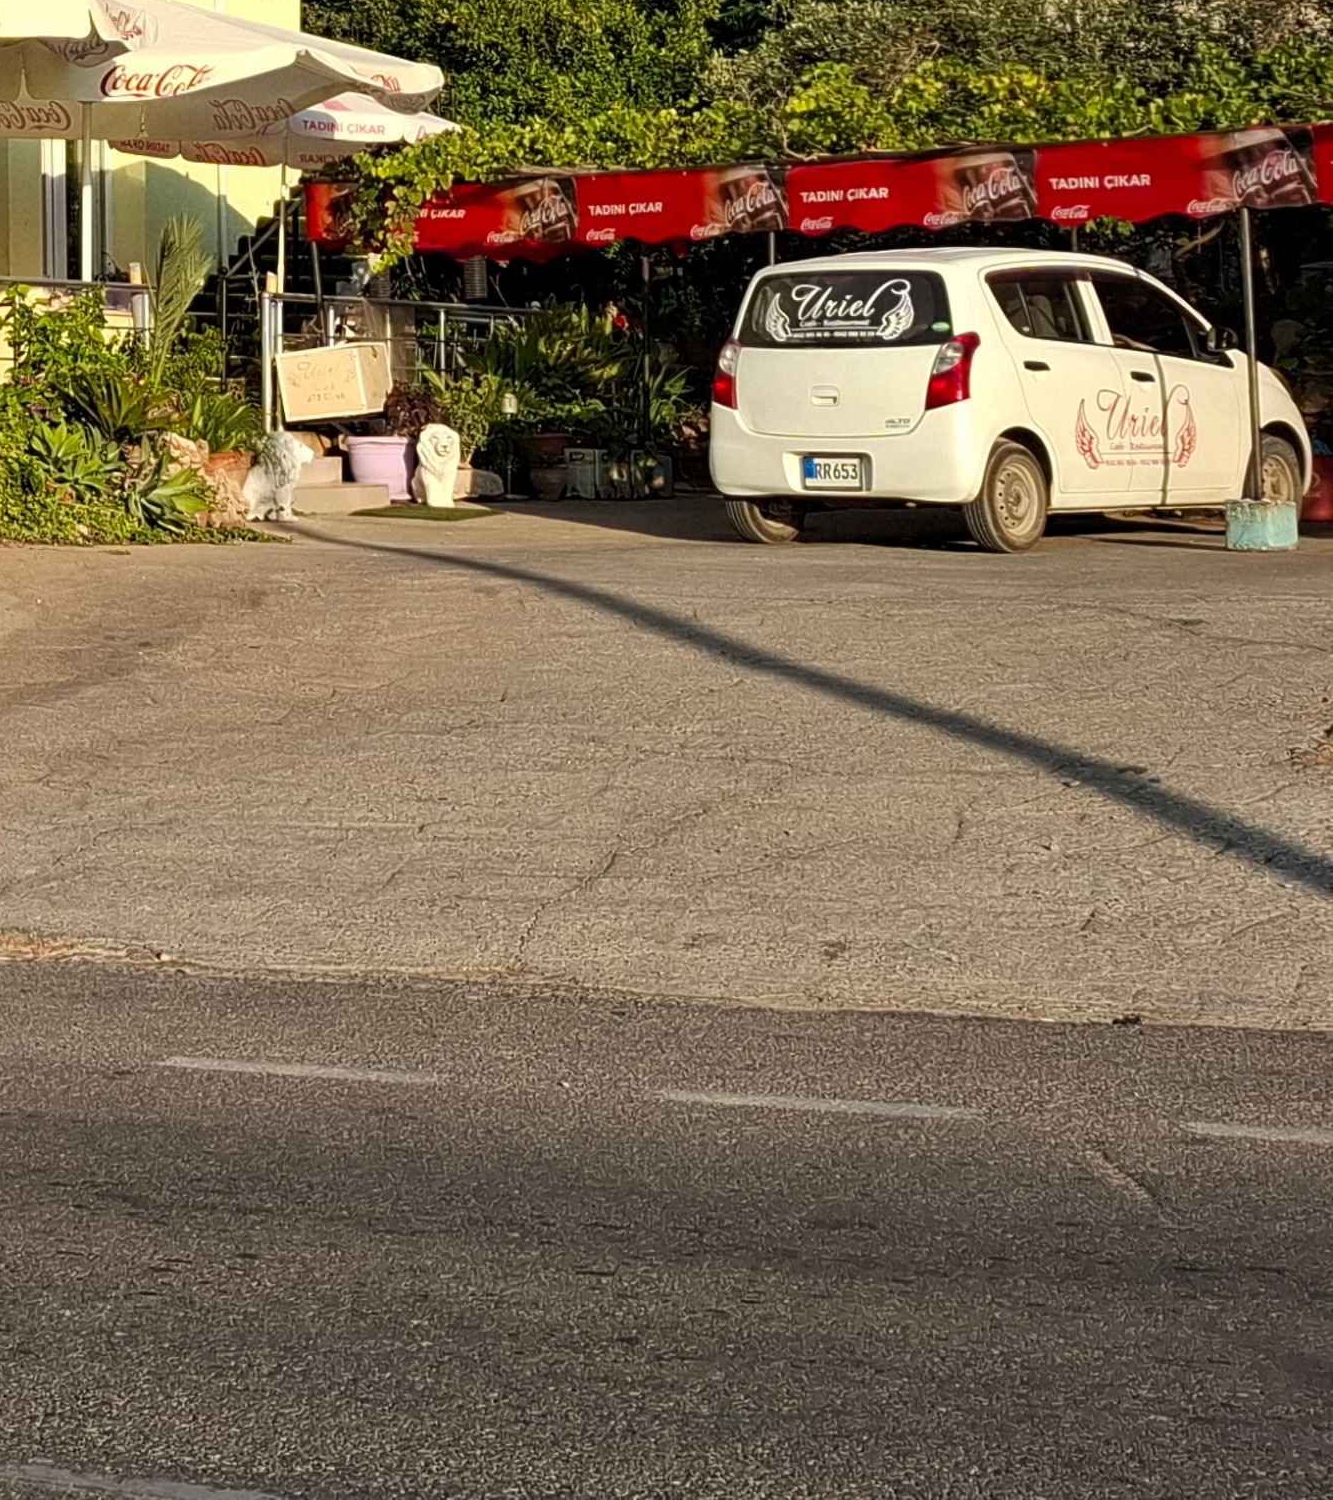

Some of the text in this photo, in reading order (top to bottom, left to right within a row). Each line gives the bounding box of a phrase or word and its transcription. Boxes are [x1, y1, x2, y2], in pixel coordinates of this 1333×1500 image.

[302, 119, 386, 136] TADINI ÇIKAR
[1233, 149, 1306, 195] Coca-Cola
[1049, 174, 1151, 190] TADINI ÇIKAR
[800, 187, 889, 203] TADINI ÇIKAR
[588, 202, 663, 217] TADINI ÇIKAR
[791, 279, 910, 322] Uriel
[1096, 384, 1190, 440] Uriel
[815, 463, 858, 480] RR653
